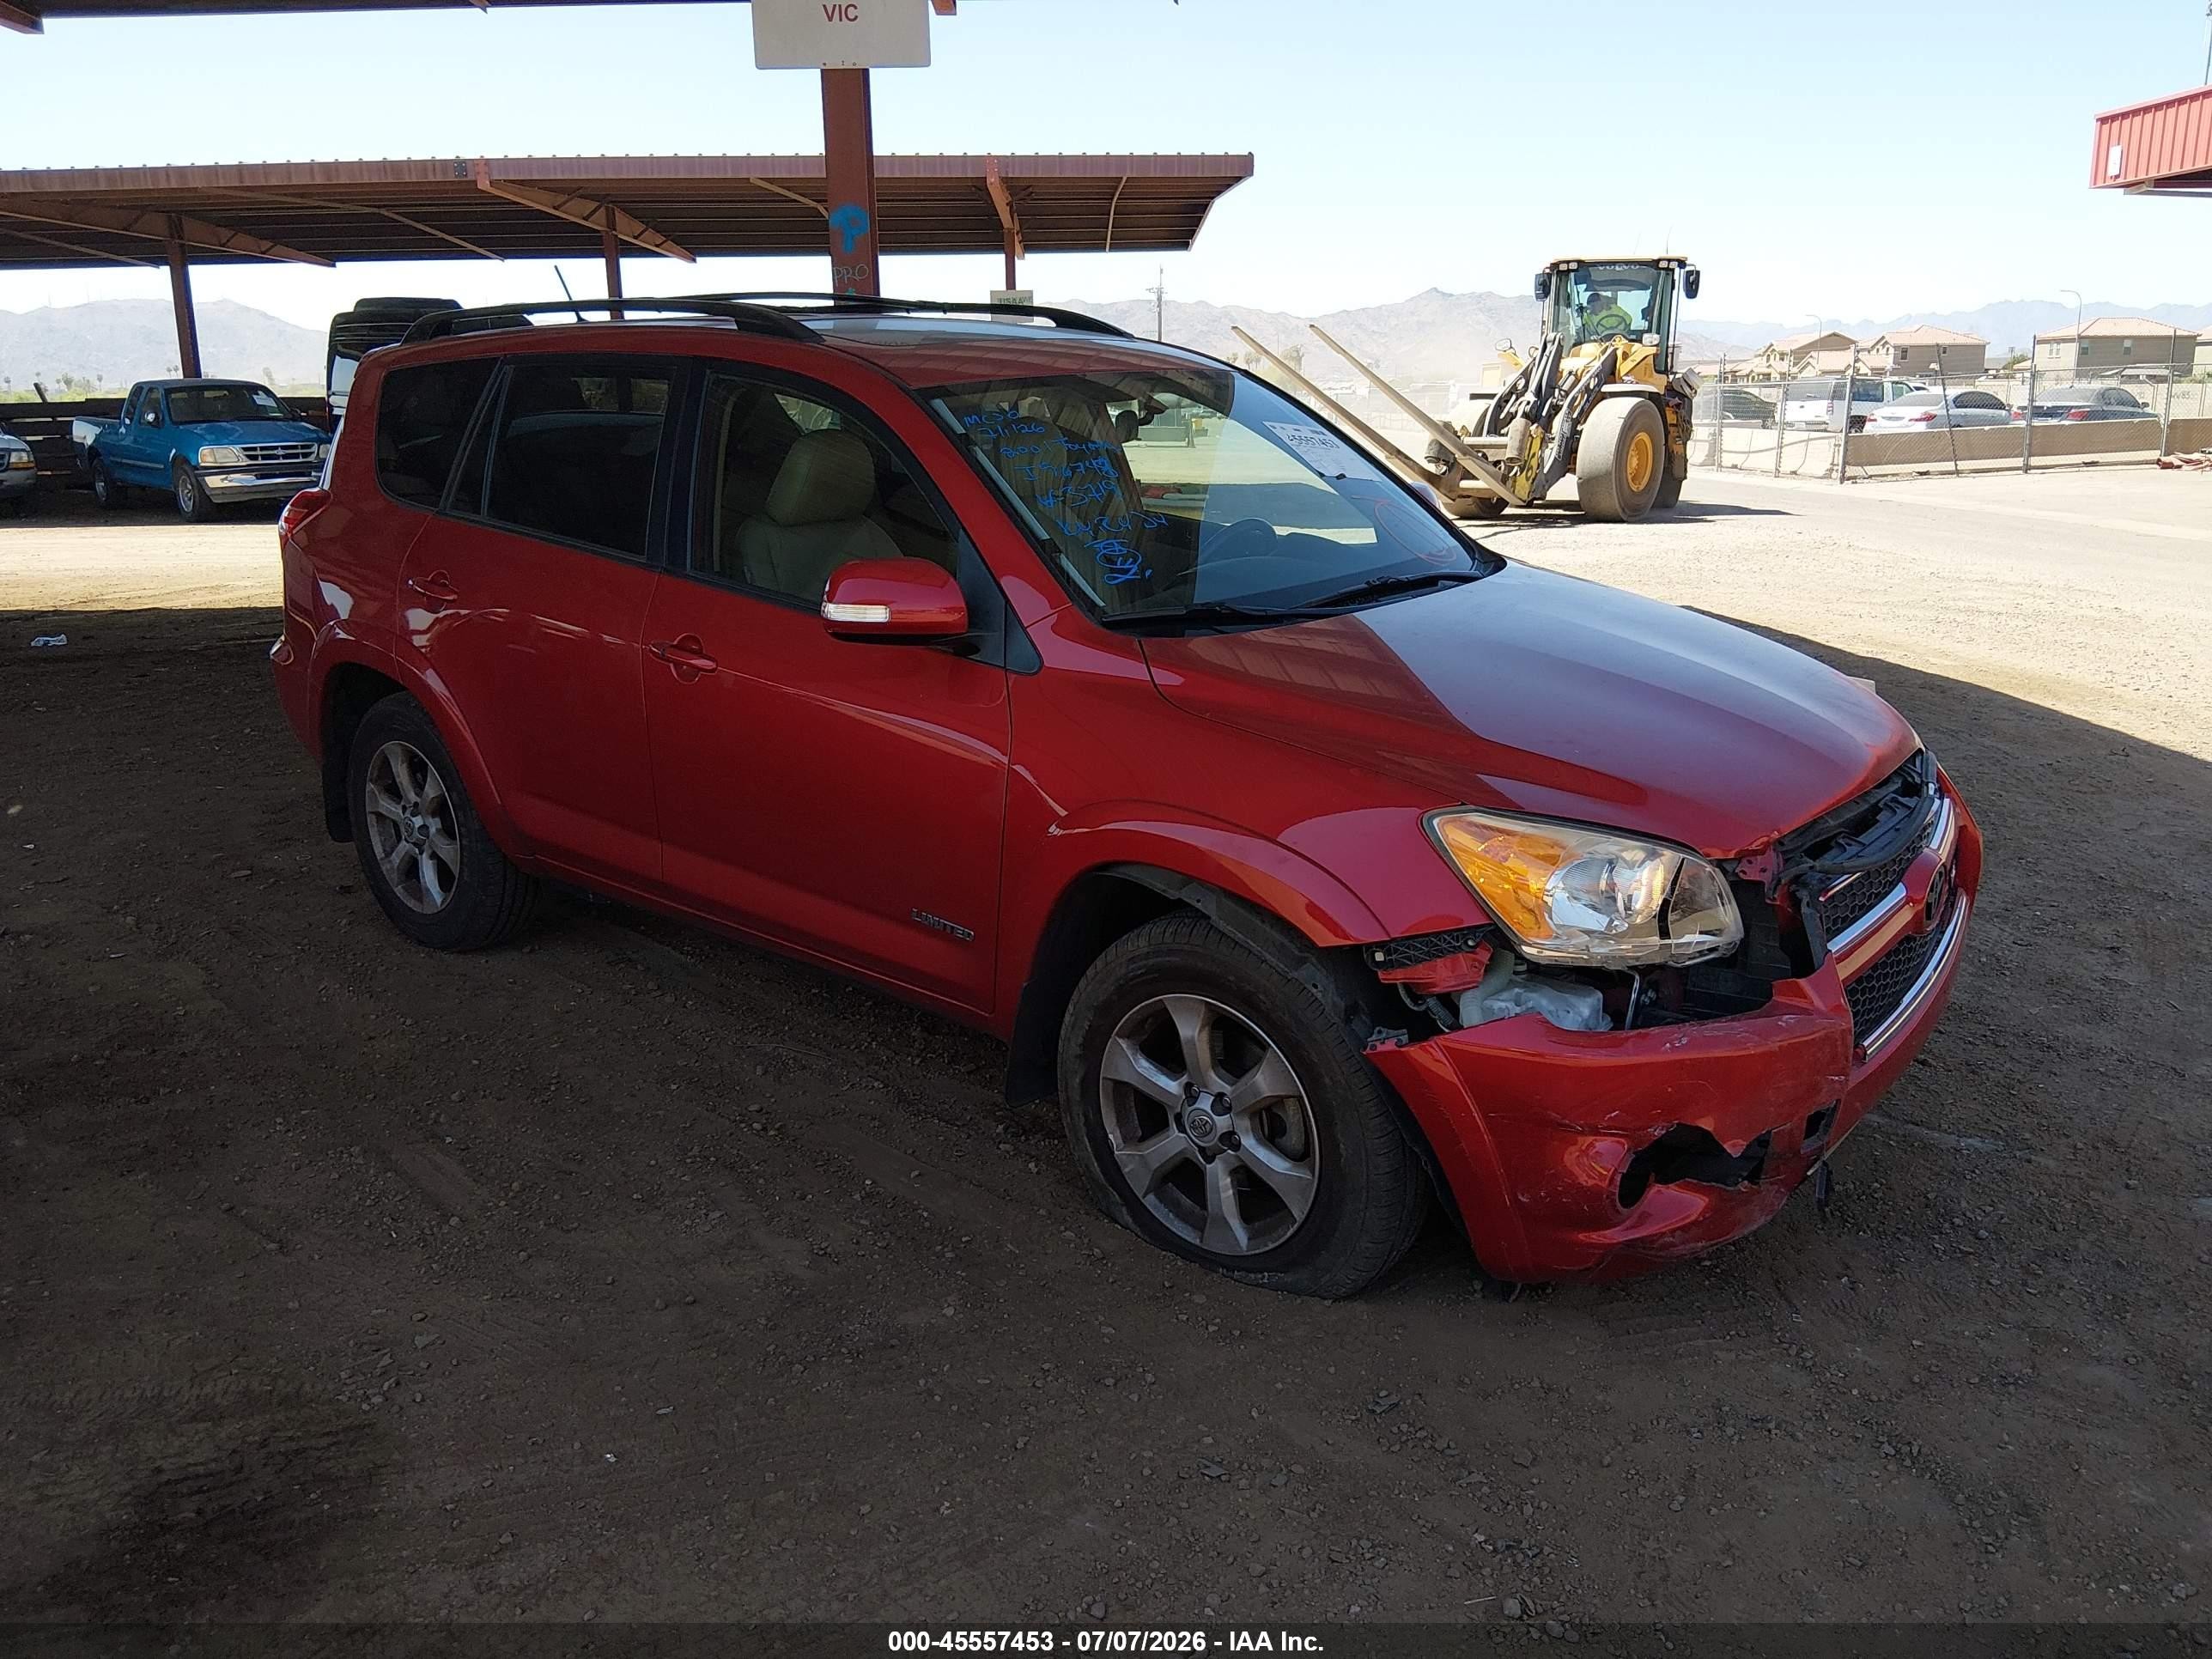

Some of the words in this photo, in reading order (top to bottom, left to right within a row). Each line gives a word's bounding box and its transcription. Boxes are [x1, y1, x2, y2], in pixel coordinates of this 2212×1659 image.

[822, 3, 859, 22] VIC
[833, 264, 869, 287] PRO
[911, 908, 975, 941] LIMITED
